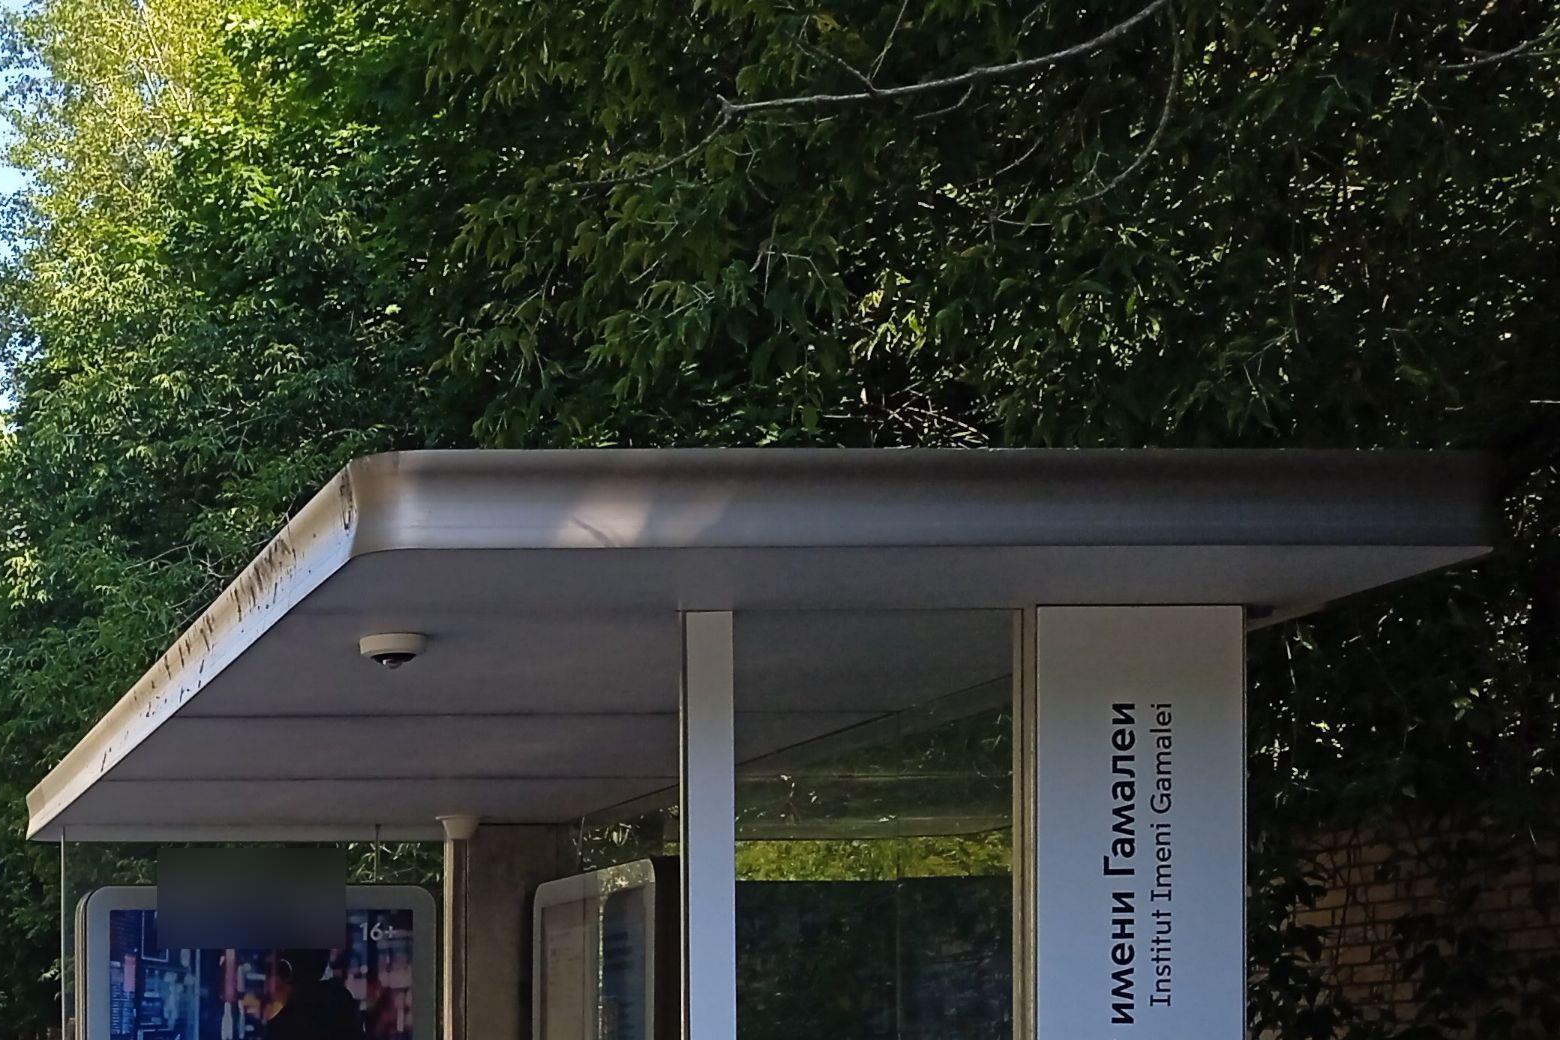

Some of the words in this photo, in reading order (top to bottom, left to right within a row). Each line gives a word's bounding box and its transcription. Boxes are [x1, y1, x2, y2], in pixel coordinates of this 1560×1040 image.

[1103, 703, 1135, 877] Гамалеи
[1149, 703, 1171, 814] Gamalei
[1149, 822, 1171, 902] Imeni
[359, 922, 396, 941] 16+
[1111, 891, 1135, 1024] имени
[1149, 909, 1171, 1007] Institut
